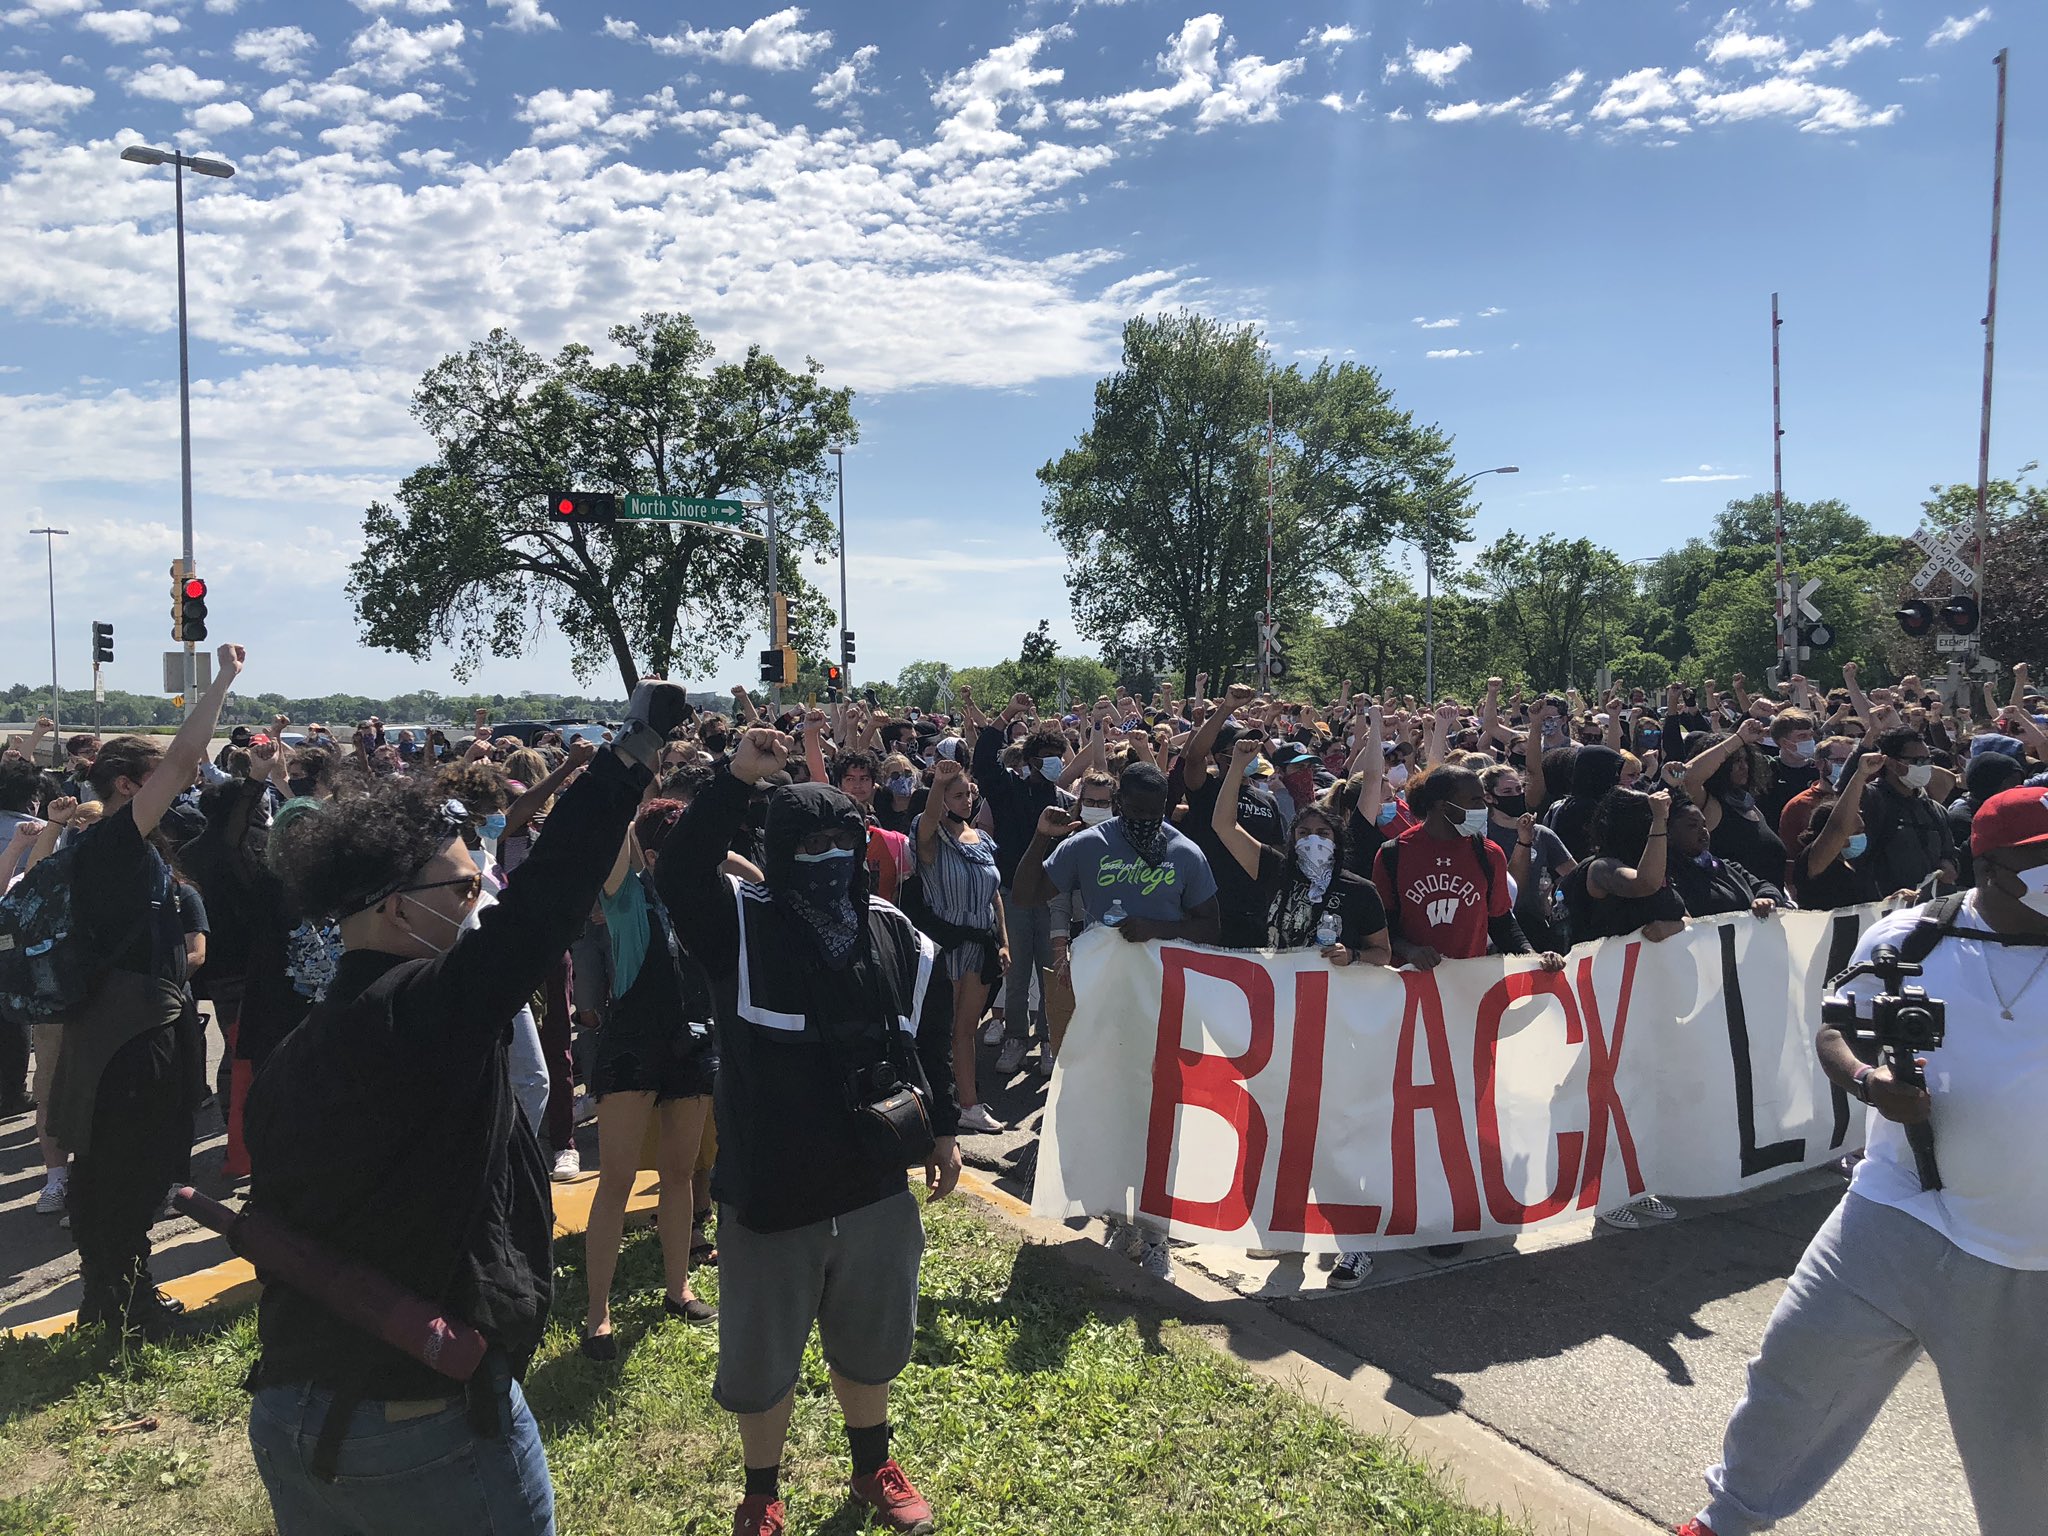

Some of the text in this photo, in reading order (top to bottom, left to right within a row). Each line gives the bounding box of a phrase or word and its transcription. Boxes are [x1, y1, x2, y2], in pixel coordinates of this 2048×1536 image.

[631, 497, 719, 518] North Shore Dr
[1914, 524, 1971, 588] CROSSING
[1939, 639, 1967, 647] EXEMPT
[1238, 802, 1273, 818] TNESS
[1096, 854, 1176, 896] College
[1405, 873, 1481, 907] BADGERS
[1426, 898, 1460, 928] W
[1139, 909, 1893, 1236] BLACK LI
